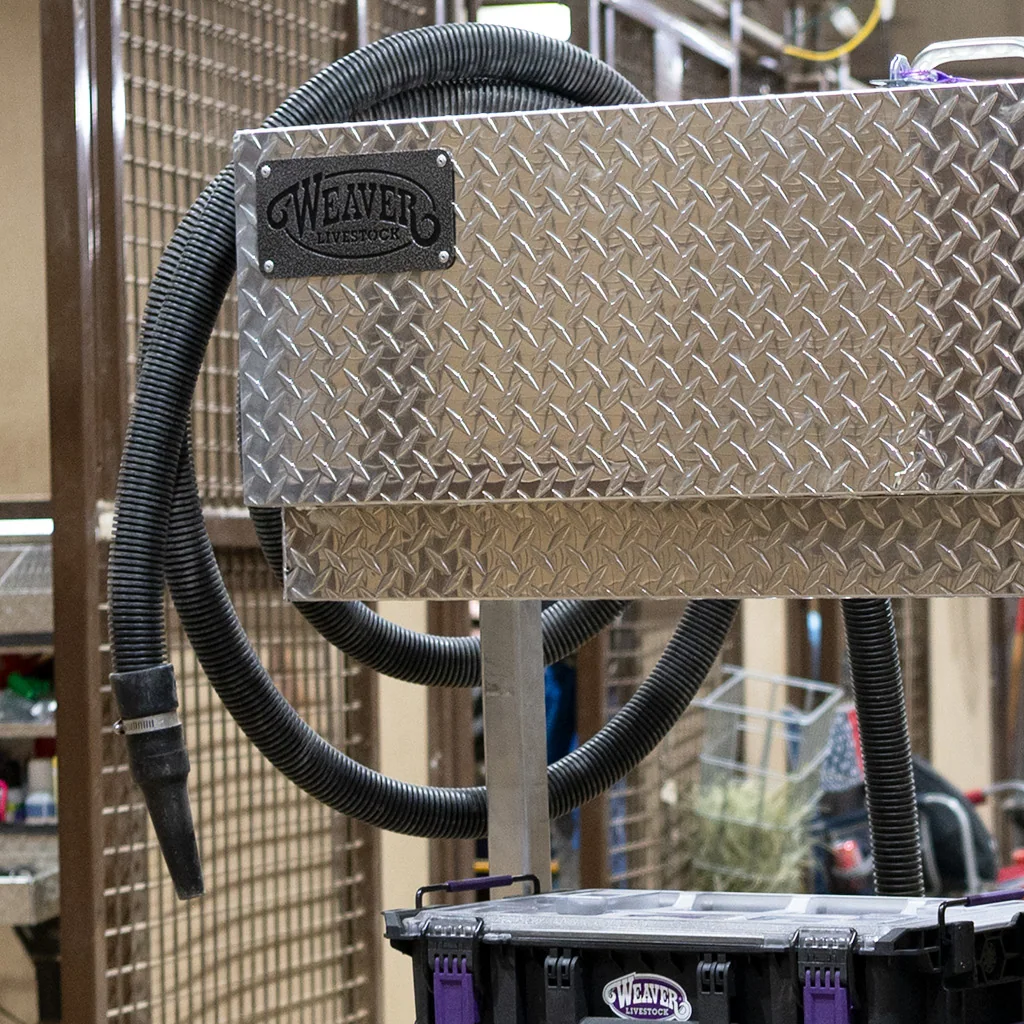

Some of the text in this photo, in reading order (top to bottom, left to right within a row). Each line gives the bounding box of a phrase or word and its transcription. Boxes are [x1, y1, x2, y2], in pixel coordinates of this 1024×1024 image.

[267, 172, 441, 248] WEAVER
[317, 228, 400, 244] LIVESTOCK
[603, 973, 692, 1021] WEAVER
[625, 1006, 669, 1016] LIVESTOCK
